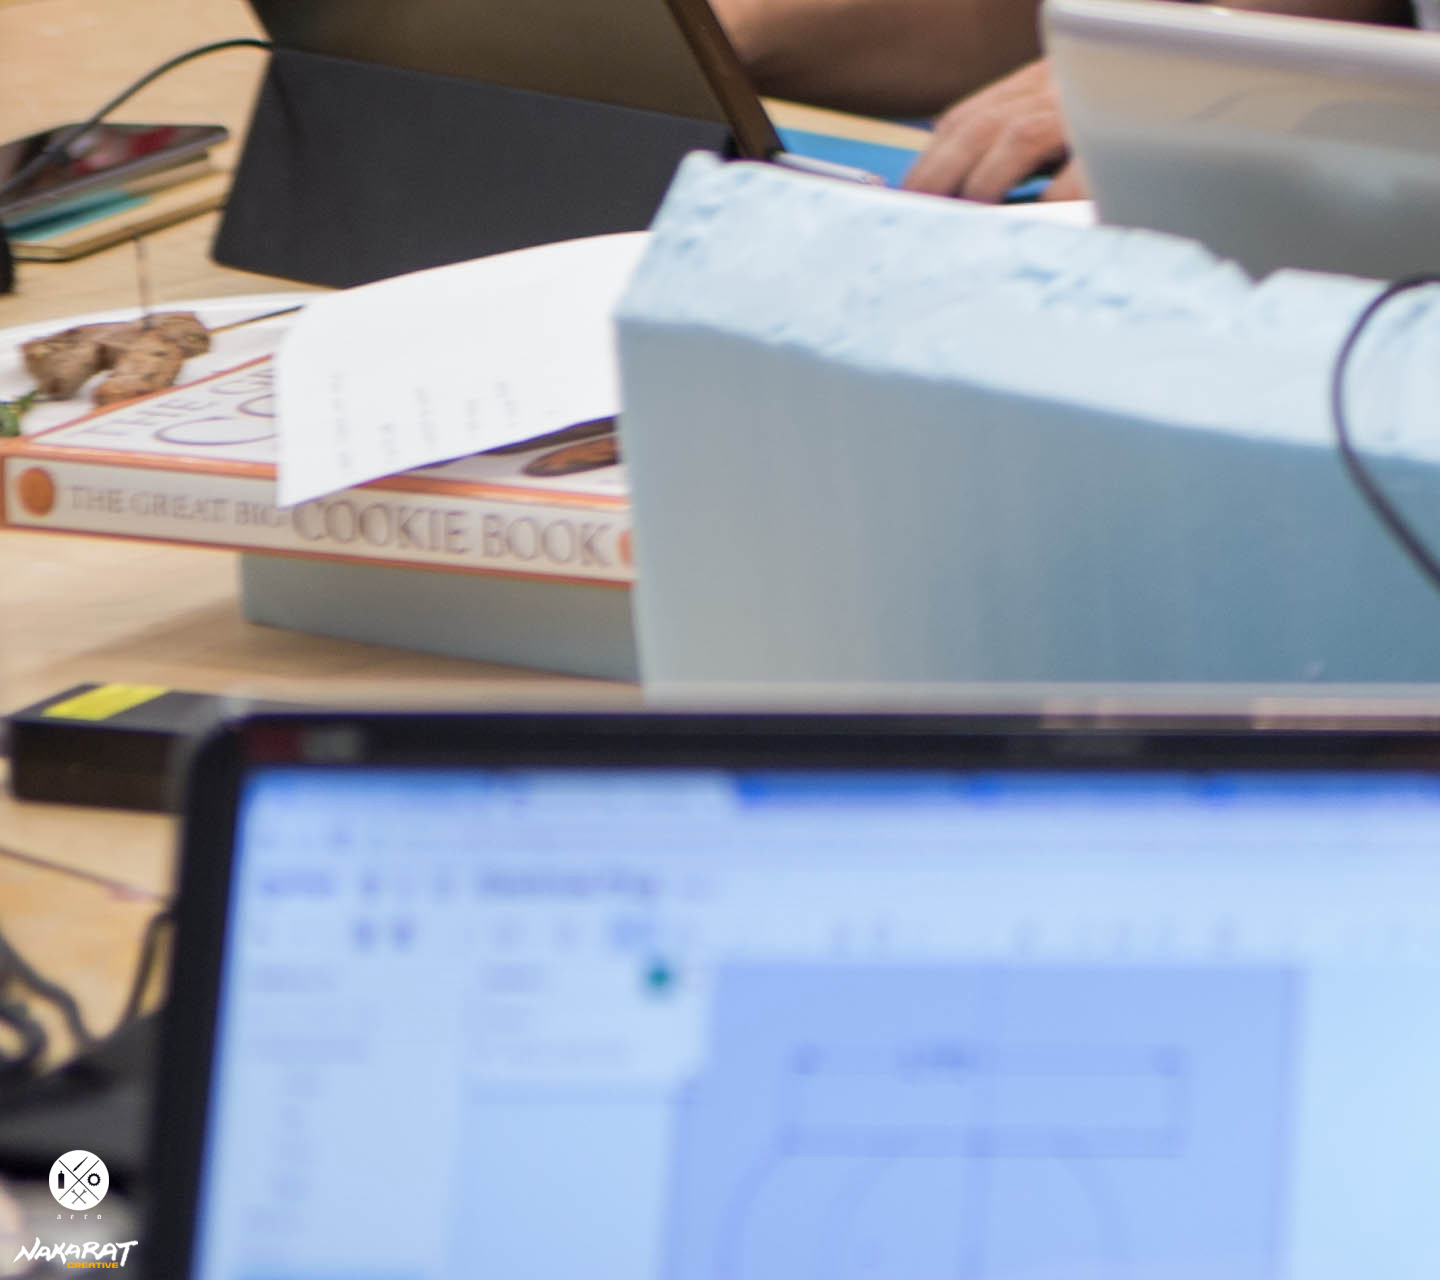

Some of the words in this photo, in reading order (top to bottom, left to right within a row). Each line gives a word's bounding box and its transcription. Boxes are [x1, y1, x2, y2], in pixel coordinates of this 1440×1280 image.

[70, 486, 125, 514] THE
[130, 492, 230, 522] GREAT
[291, 498, 472, 555] COOKIE
[481, 513, 611, 567] BOOK
